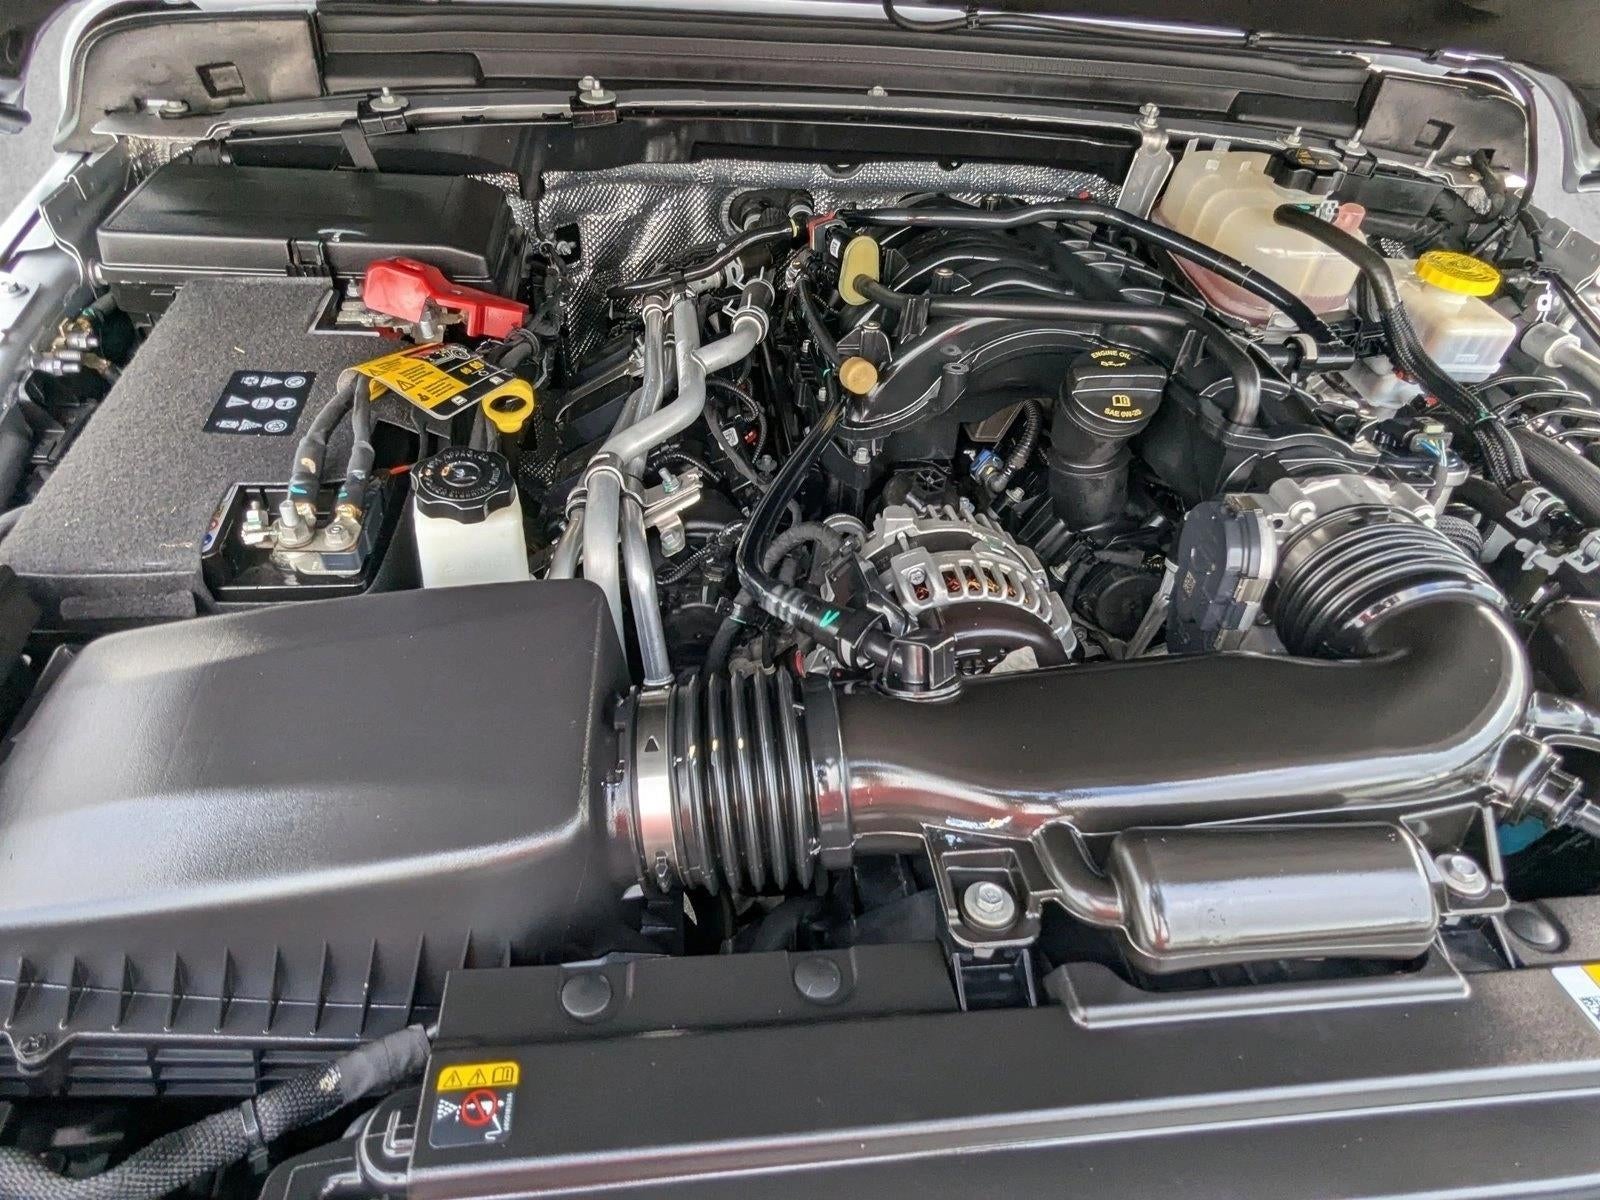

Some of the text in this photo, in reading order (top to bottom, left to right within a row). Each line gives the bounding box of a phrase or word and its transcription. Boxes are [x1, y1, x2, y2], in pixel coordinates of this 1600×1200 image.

[1091, 350, 1131, 360] ENGINE OIL
[1104, 407, 1120, 417] SAE
